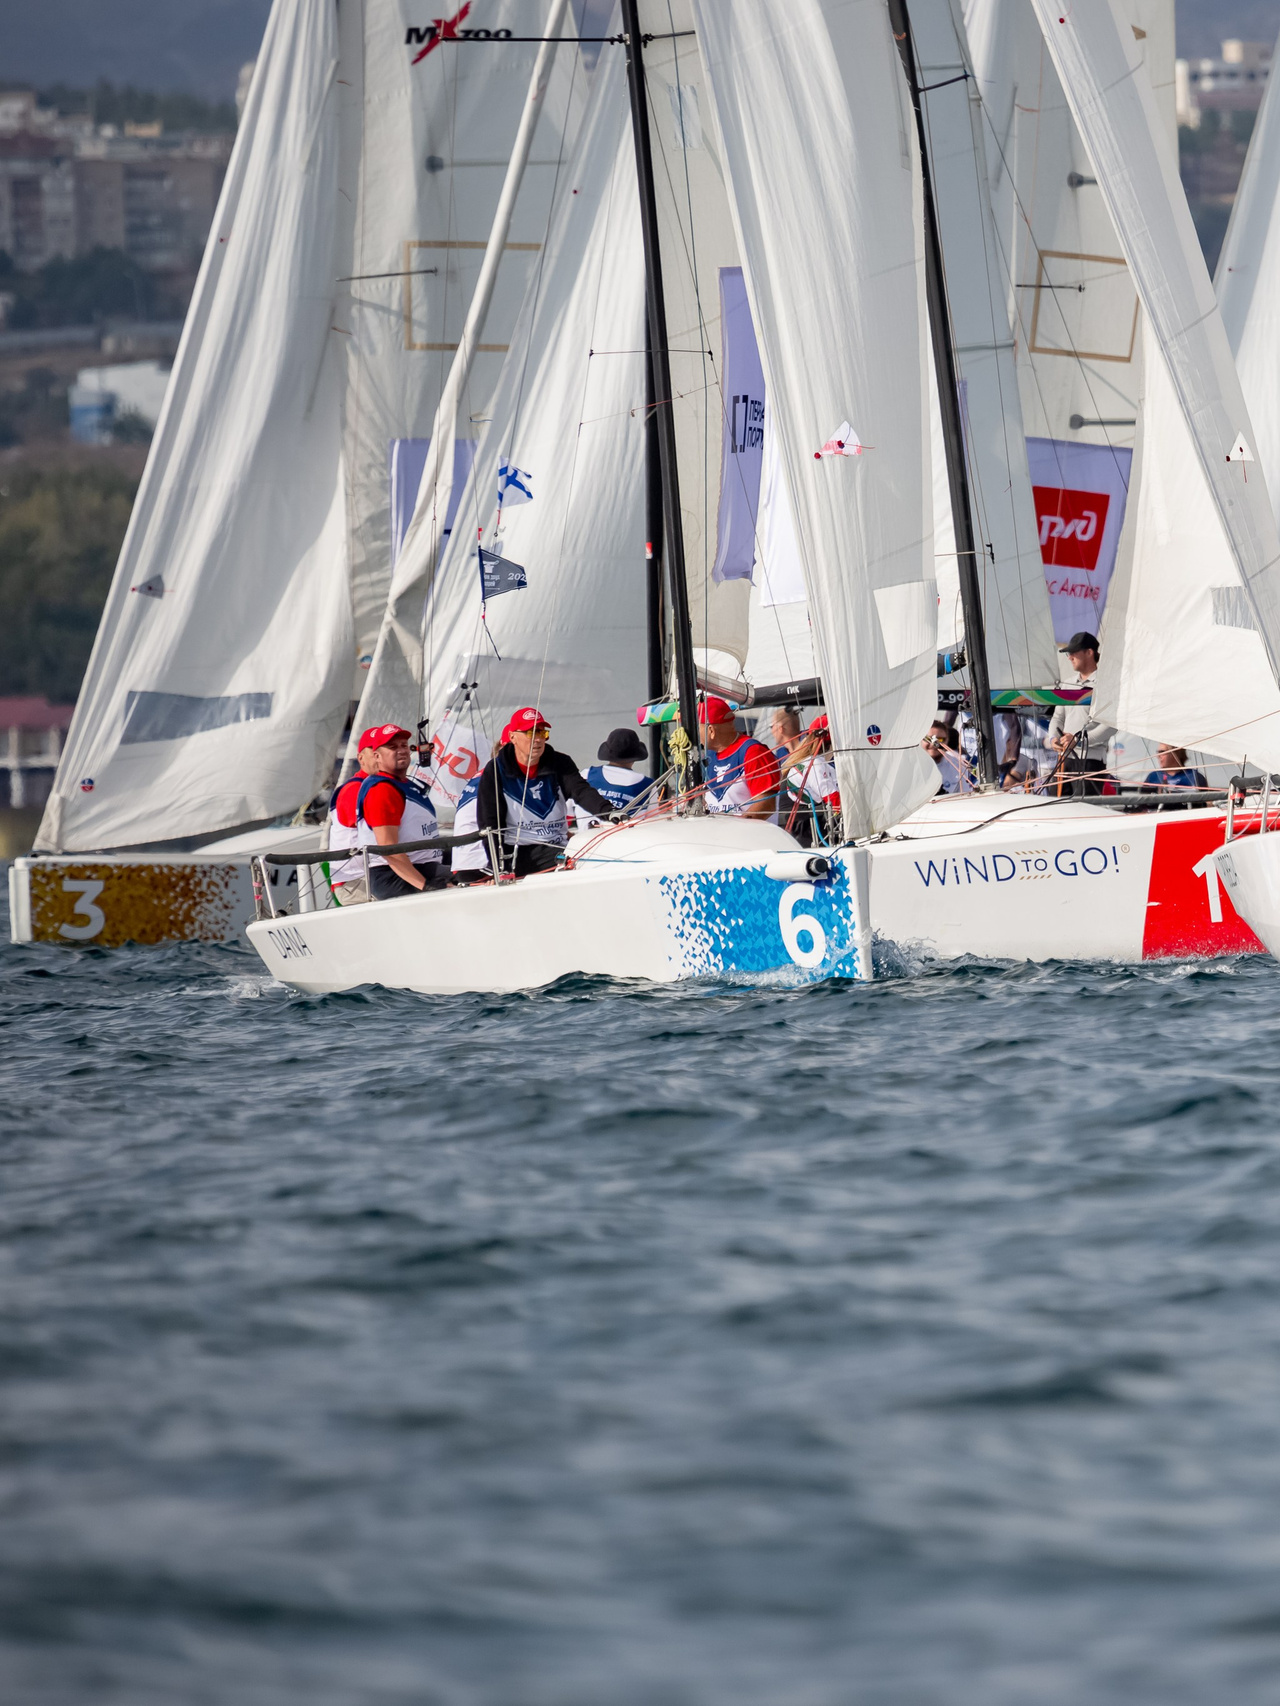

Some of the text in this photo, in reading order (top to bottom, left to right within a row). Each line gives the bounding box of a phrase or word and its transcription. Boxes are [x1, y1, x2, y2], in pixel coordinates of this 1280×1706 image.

[58, 880, 106, 940] 3
[778, 882, 826, 969] 6
[267, 926, 313, 959] DANA
